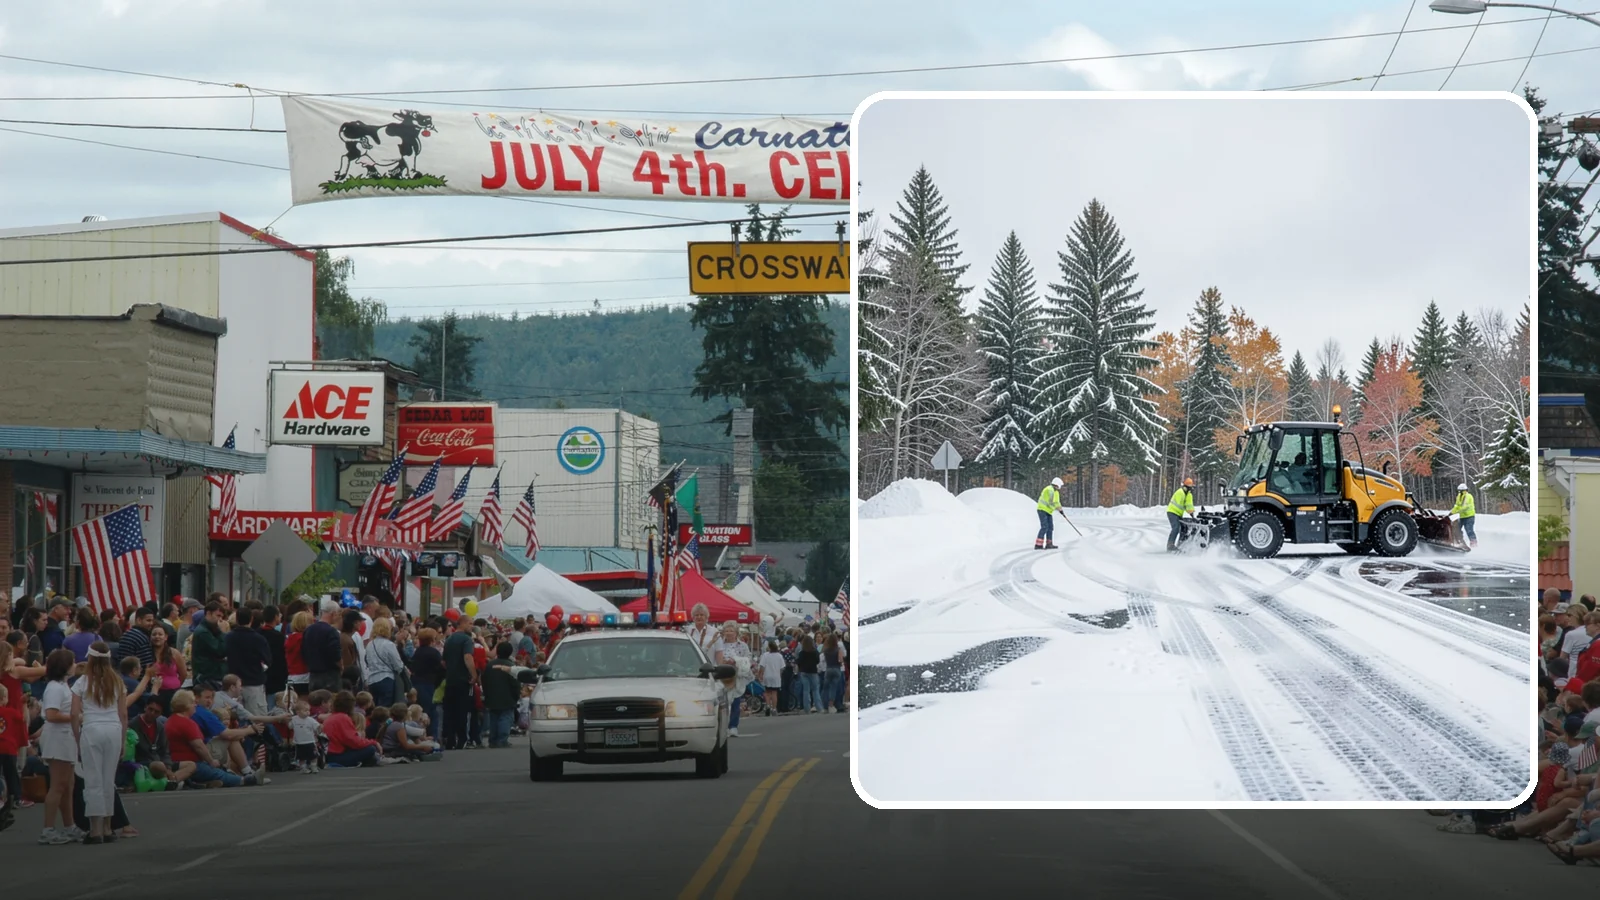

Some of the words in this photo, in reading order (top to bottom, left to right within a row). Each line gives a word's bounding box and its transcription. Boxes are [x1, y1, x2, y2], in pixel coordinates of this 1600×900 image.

[481, 141, 605, 193] JULY
[633, 149, 746, 198] 4th.
[697, 254, 850, 280] CROSSWA
[283, 380, 373, 420] ACE
[405, 409, 452, 422] CEDAR
[461, 409, 485, 422] LOG
[283, 421, 371, 437] Hardware
[353, 467, 385, 480] Simpl
[95, 485, 124, 495] Vincent
[126, 485, 135, 495] de
[137, 486, 155, 495] Paul
[699, 535, 730, 543] GLASS
